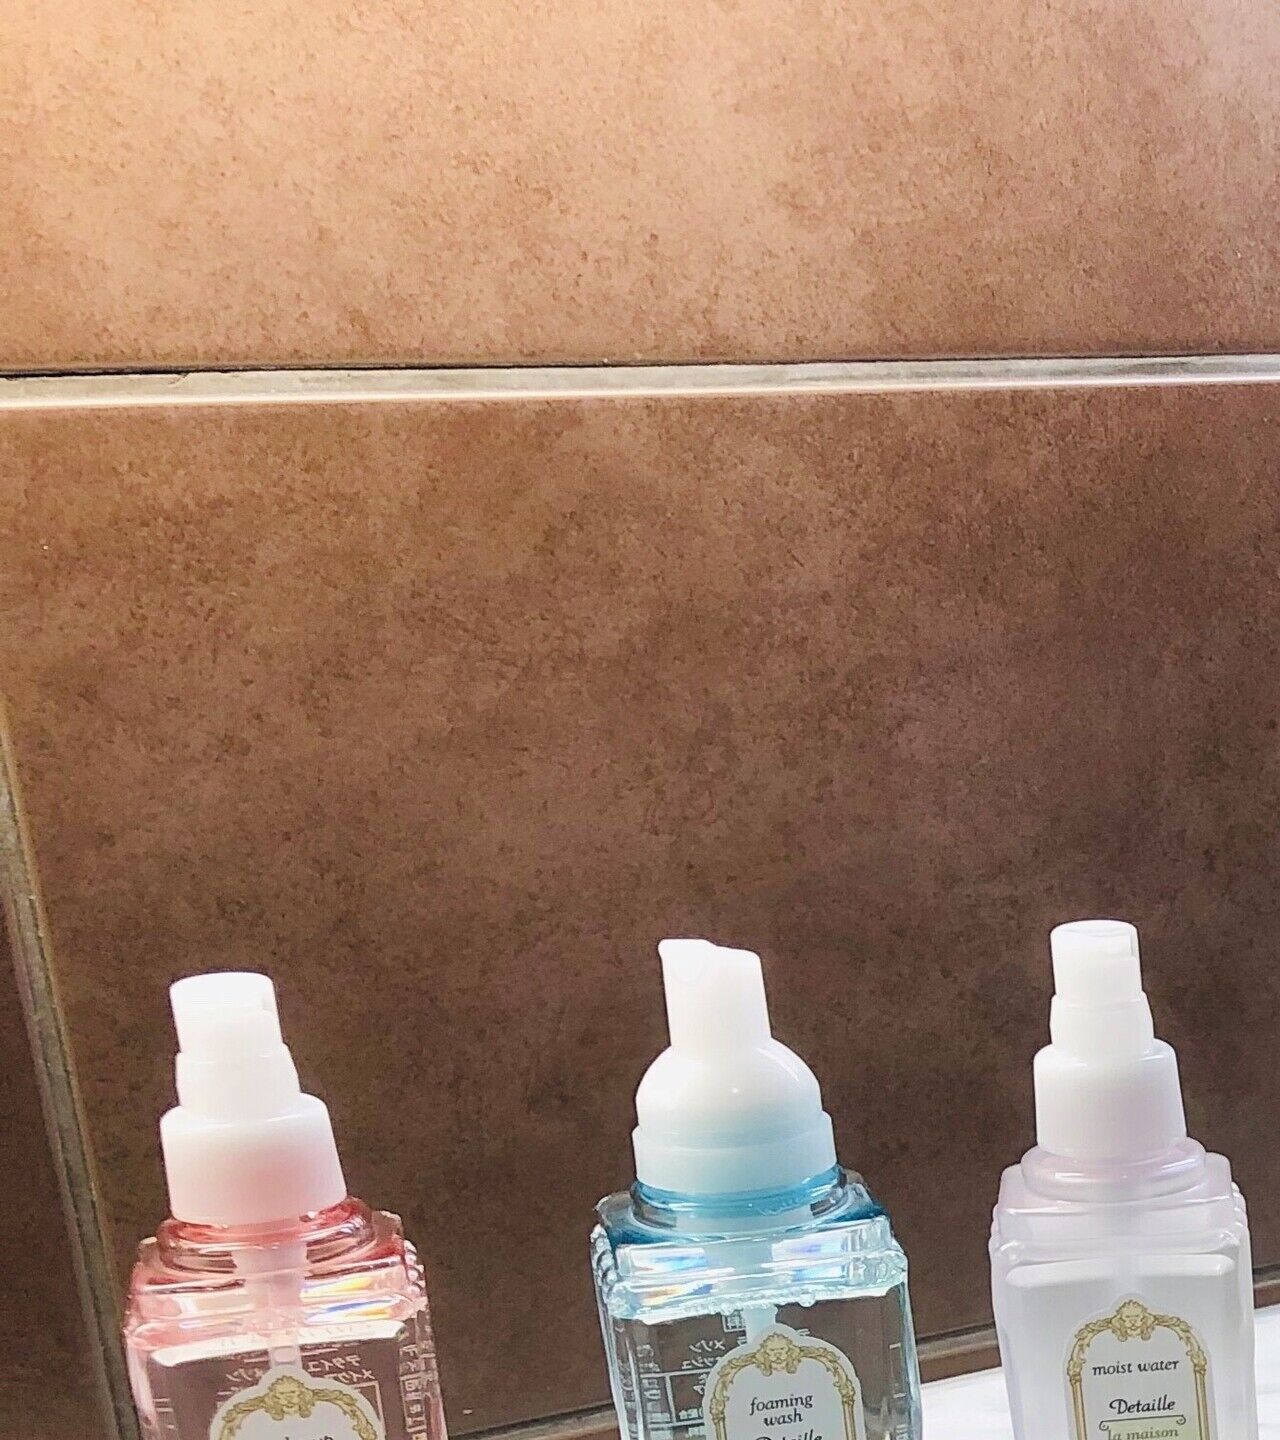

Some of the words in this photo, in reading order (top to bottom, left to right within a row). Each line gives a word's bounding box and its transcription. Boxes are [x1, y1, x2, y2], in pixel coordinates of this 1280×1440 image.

[1092, 1362, 1132, 1376] moist
[1138, 1360, 1180, 1373] water
[749, 1394, 814, 1416] foaming
[1109, 1394, 1175, 1414] Detaille
[763, 1411, 803, 1427] wash
[1127, 1426, 1178, 1440] maison
